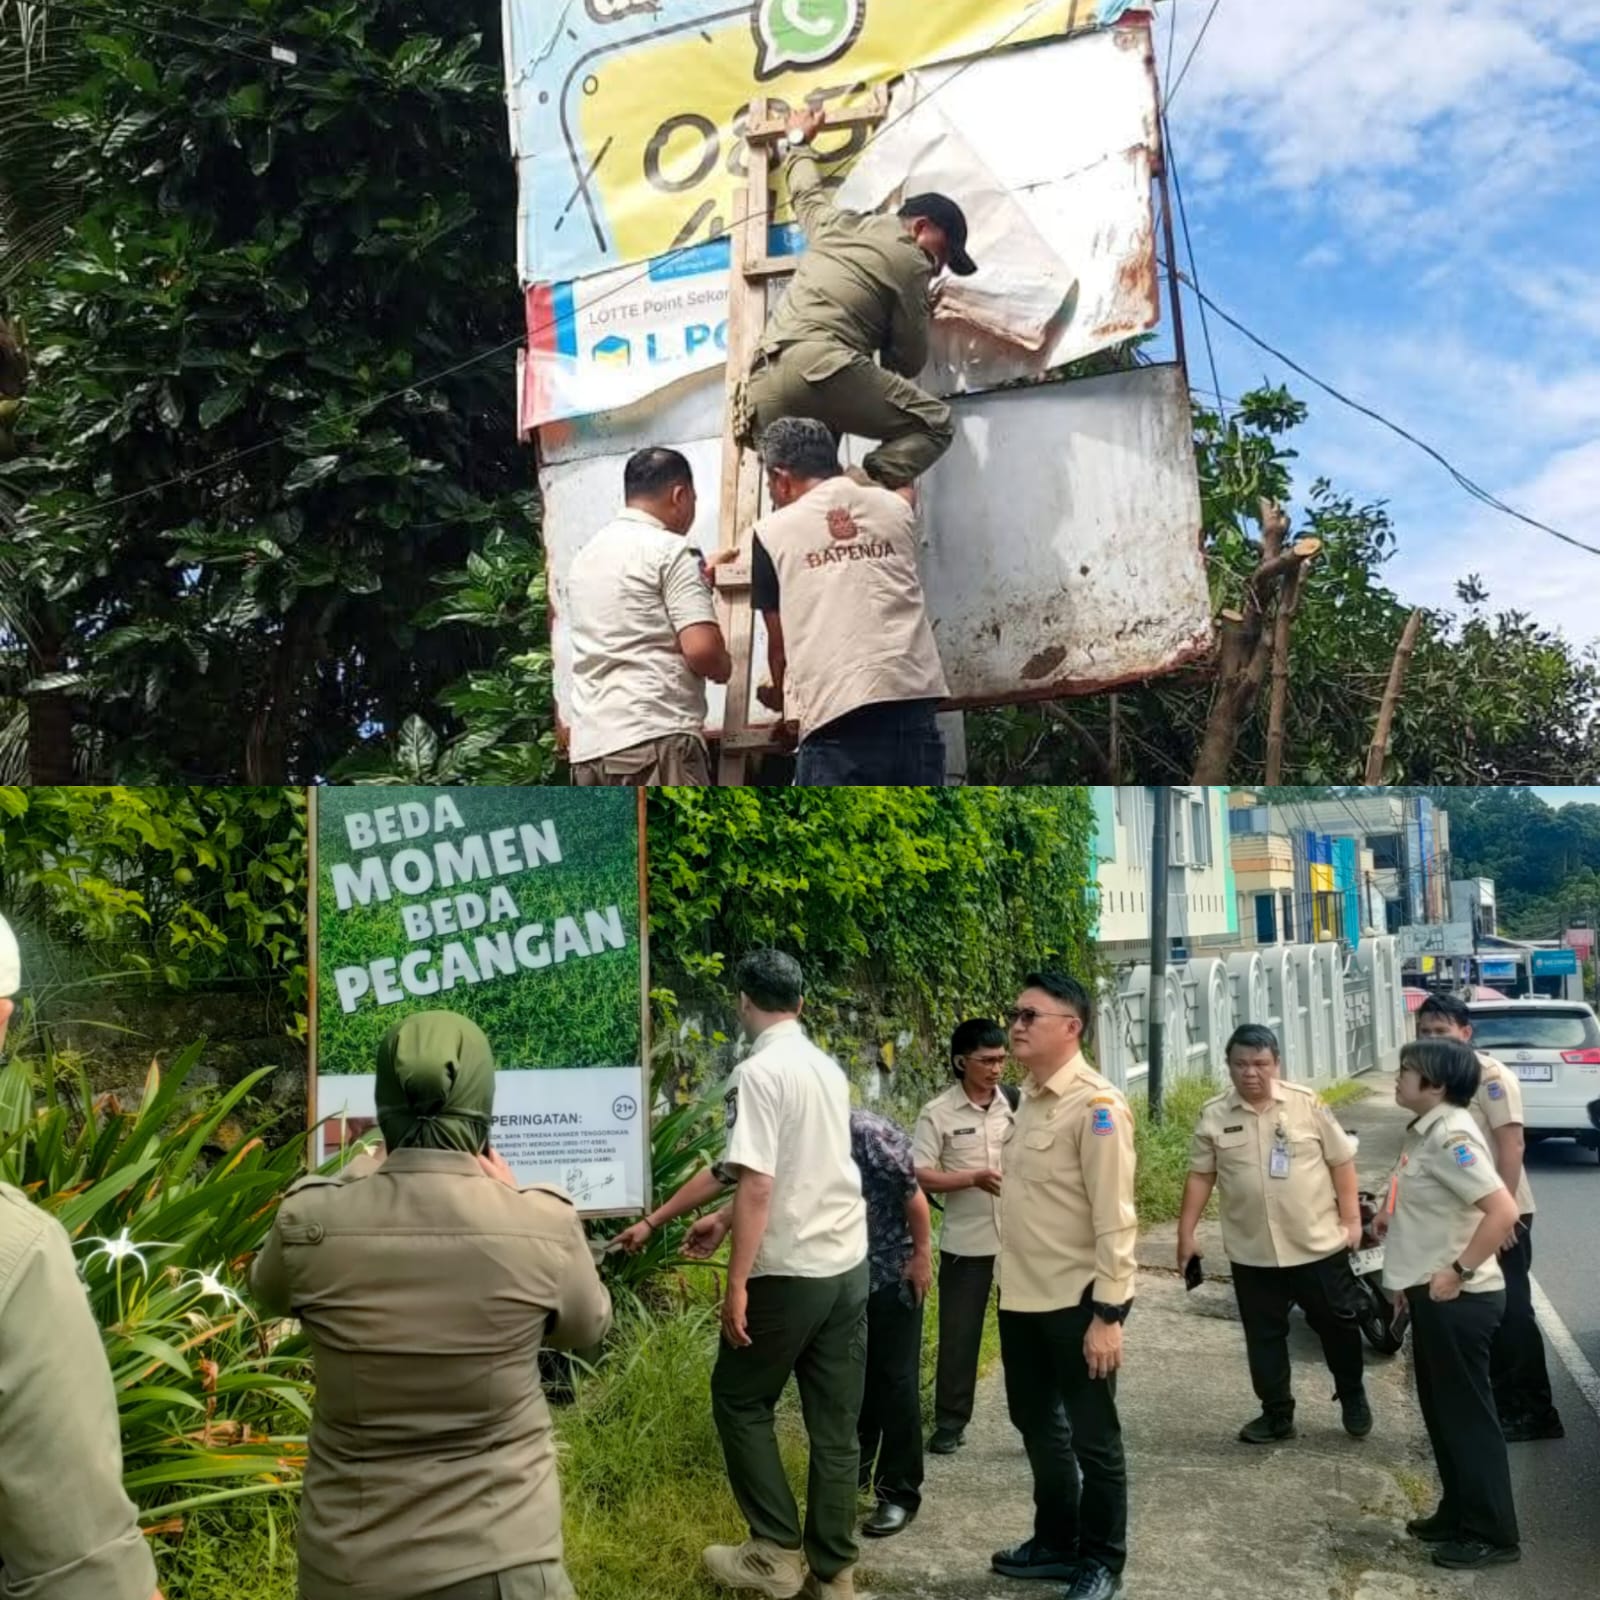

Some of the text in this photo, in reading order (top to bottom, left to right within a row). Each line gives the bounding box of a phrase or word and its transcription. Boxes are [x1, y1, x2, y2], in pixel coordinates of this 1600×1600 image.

[589, 303, 640, 326] LOTTE
[643, 296, 683, 314] Point
[687, 288, 730, 306] Sekar
[805, 540, 897, 568] BAPENDA
[344, 794, 465, 850] BEDA
[330, 819, 563, 911] MOMEN
[401, 885, 520, 942] BEDA
[333, 905, 627, 1014] PEGANGAN
[491, 1113, 583, 1127] PERINGATAN:
[615, 1103, 634, 1113] 21+
[529, 1140, 561, 1148] MEROKOK
